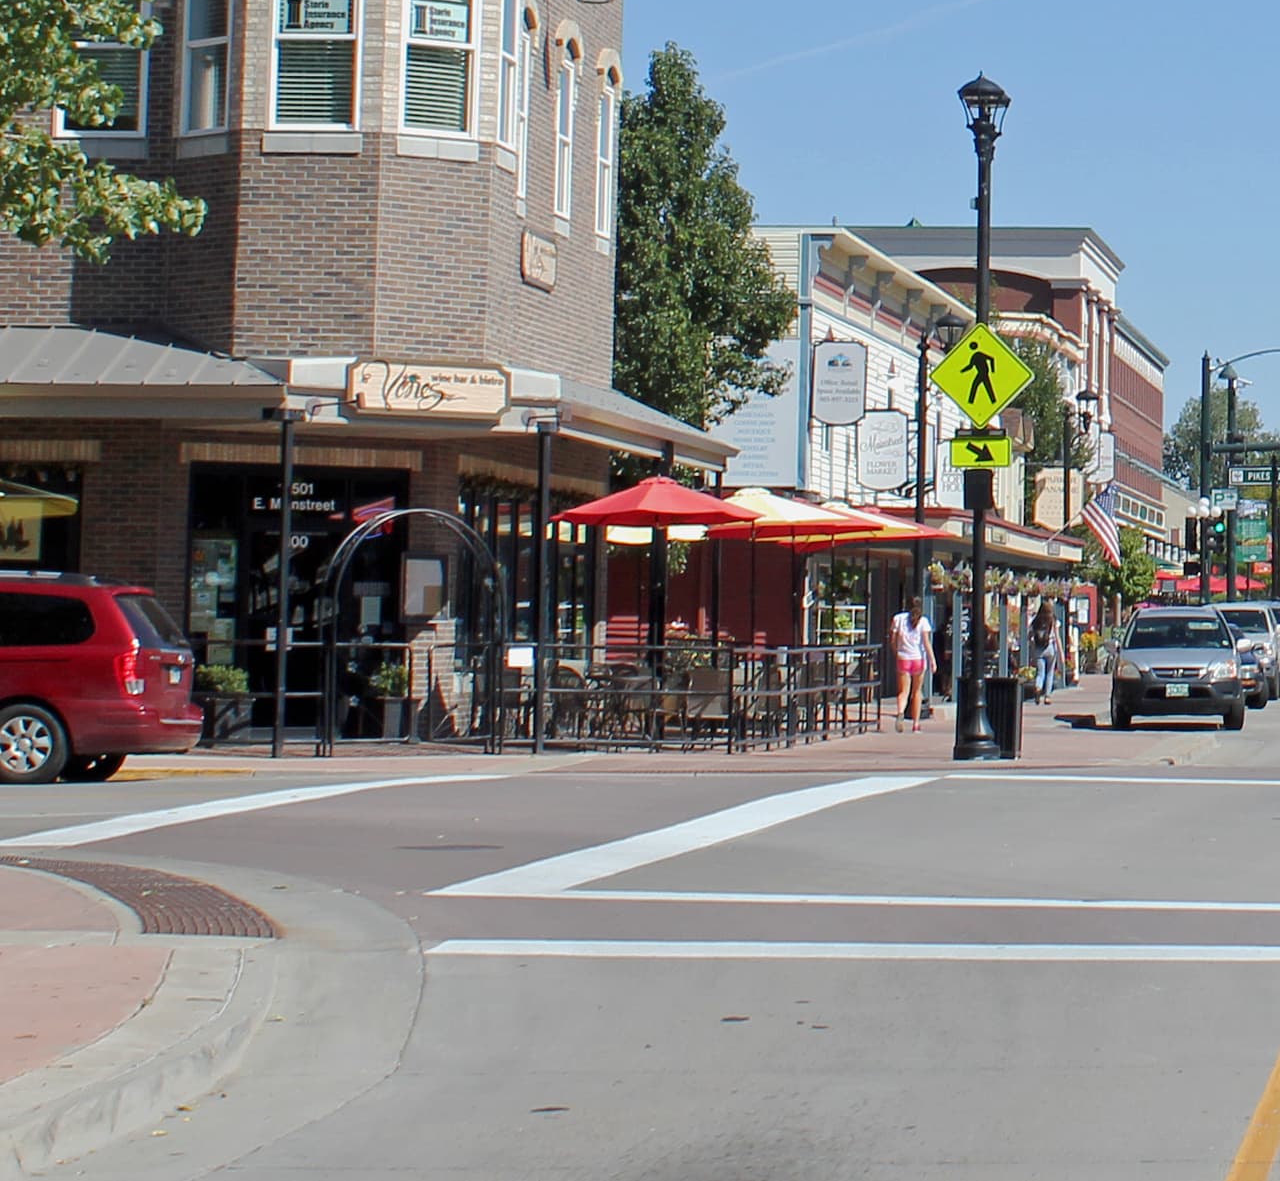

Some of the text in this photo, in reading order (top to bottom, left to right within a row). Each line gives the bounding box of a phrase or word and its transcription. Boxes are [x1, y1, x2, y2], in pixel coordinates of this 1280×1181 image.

[304, 10, 346, 19] Insurance
[304, 20, 334, 29] Agency
[429, 18, 465, 28] Insurance
[429, 26, 456, 37] Agency
[431, 374, 504, 385] wine bar & bistro
[362, 360, 446, 411] Vines
[866, 467, 898, 475] MARKET
[1247, 472, 1271, 480] PIKES
[269, 498, 335, 511] Mnstreet
[1214, 493, 1225, 506] P
